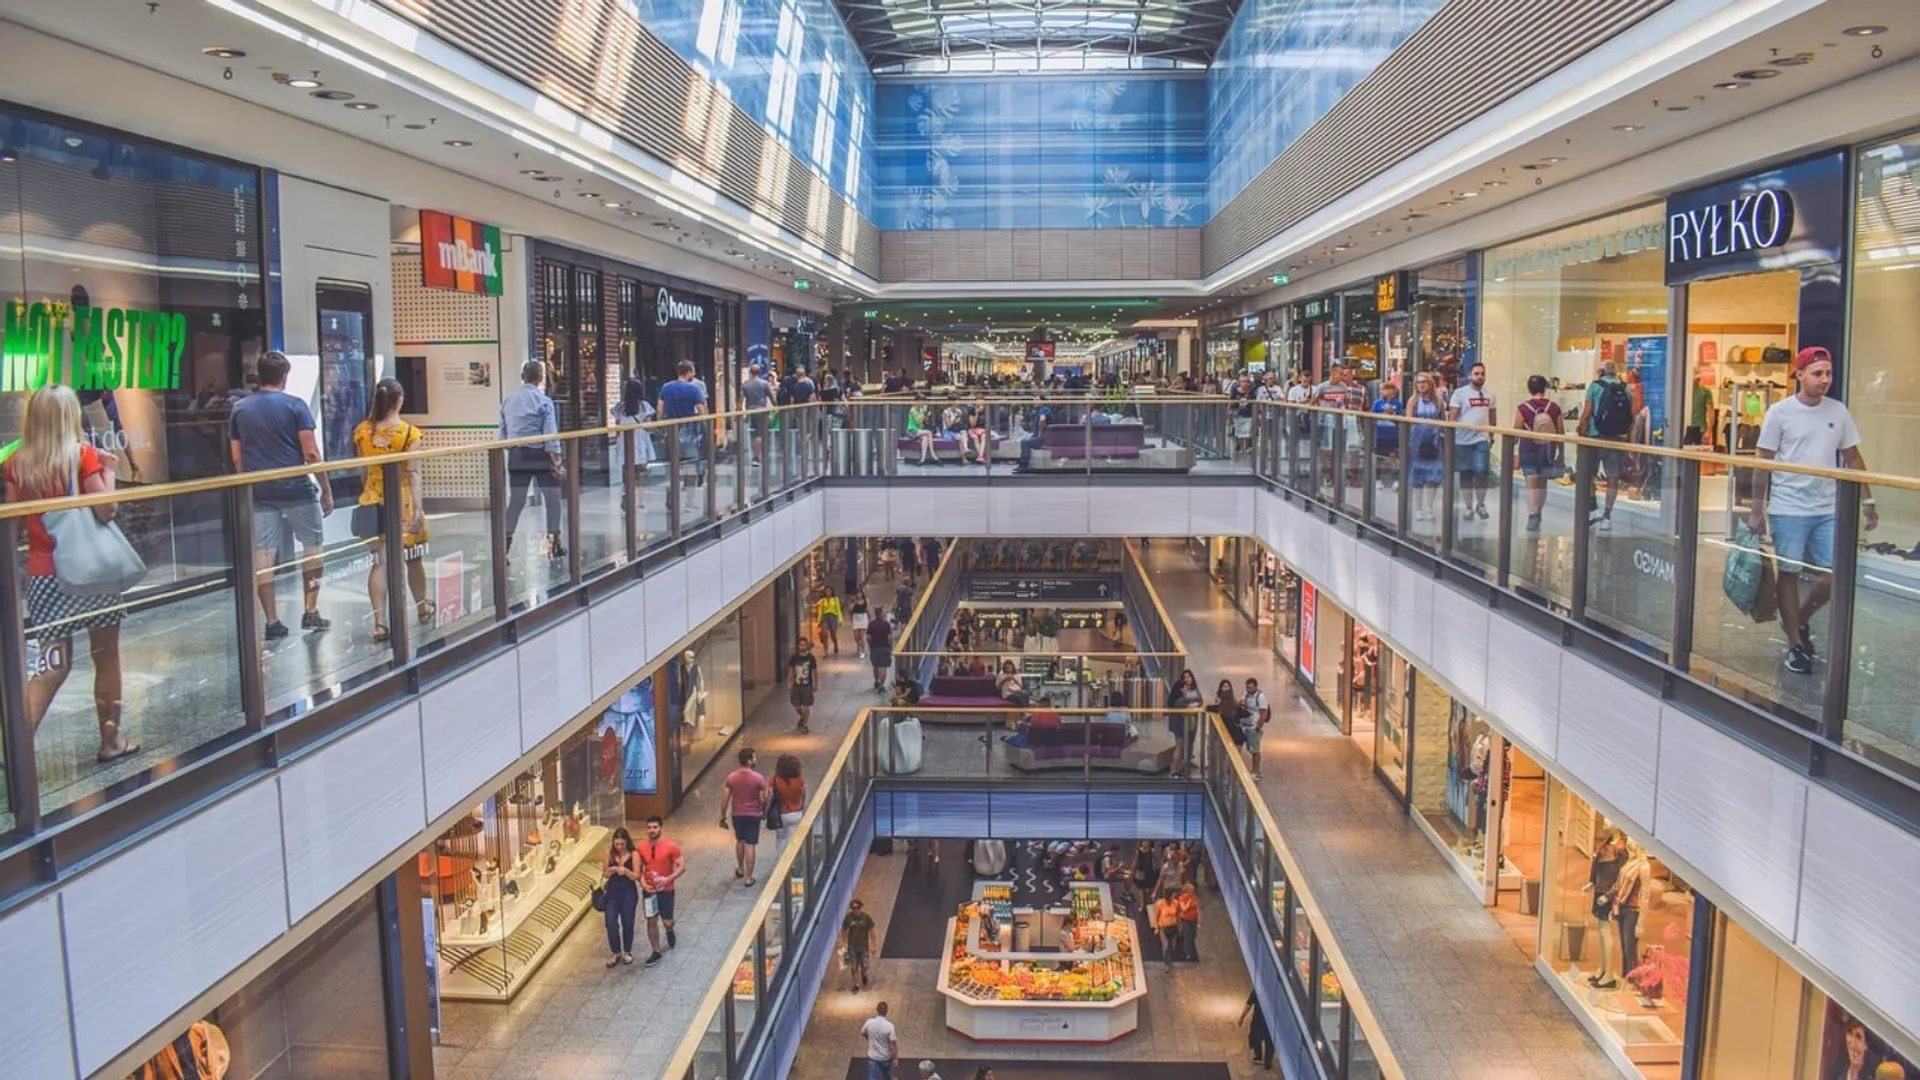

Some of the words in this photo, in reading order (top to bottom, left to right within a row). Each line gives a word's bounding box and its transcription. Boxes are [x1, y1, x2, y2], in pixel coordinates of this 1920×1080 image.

[1669, 189, 1780, 263] RYŁKO
[438, 238, 499, 278] mBank
[1, 300, 68, 392] NOT
[71, 305, 187, 392] FASTER?
[102, 420, 128, 450] do
